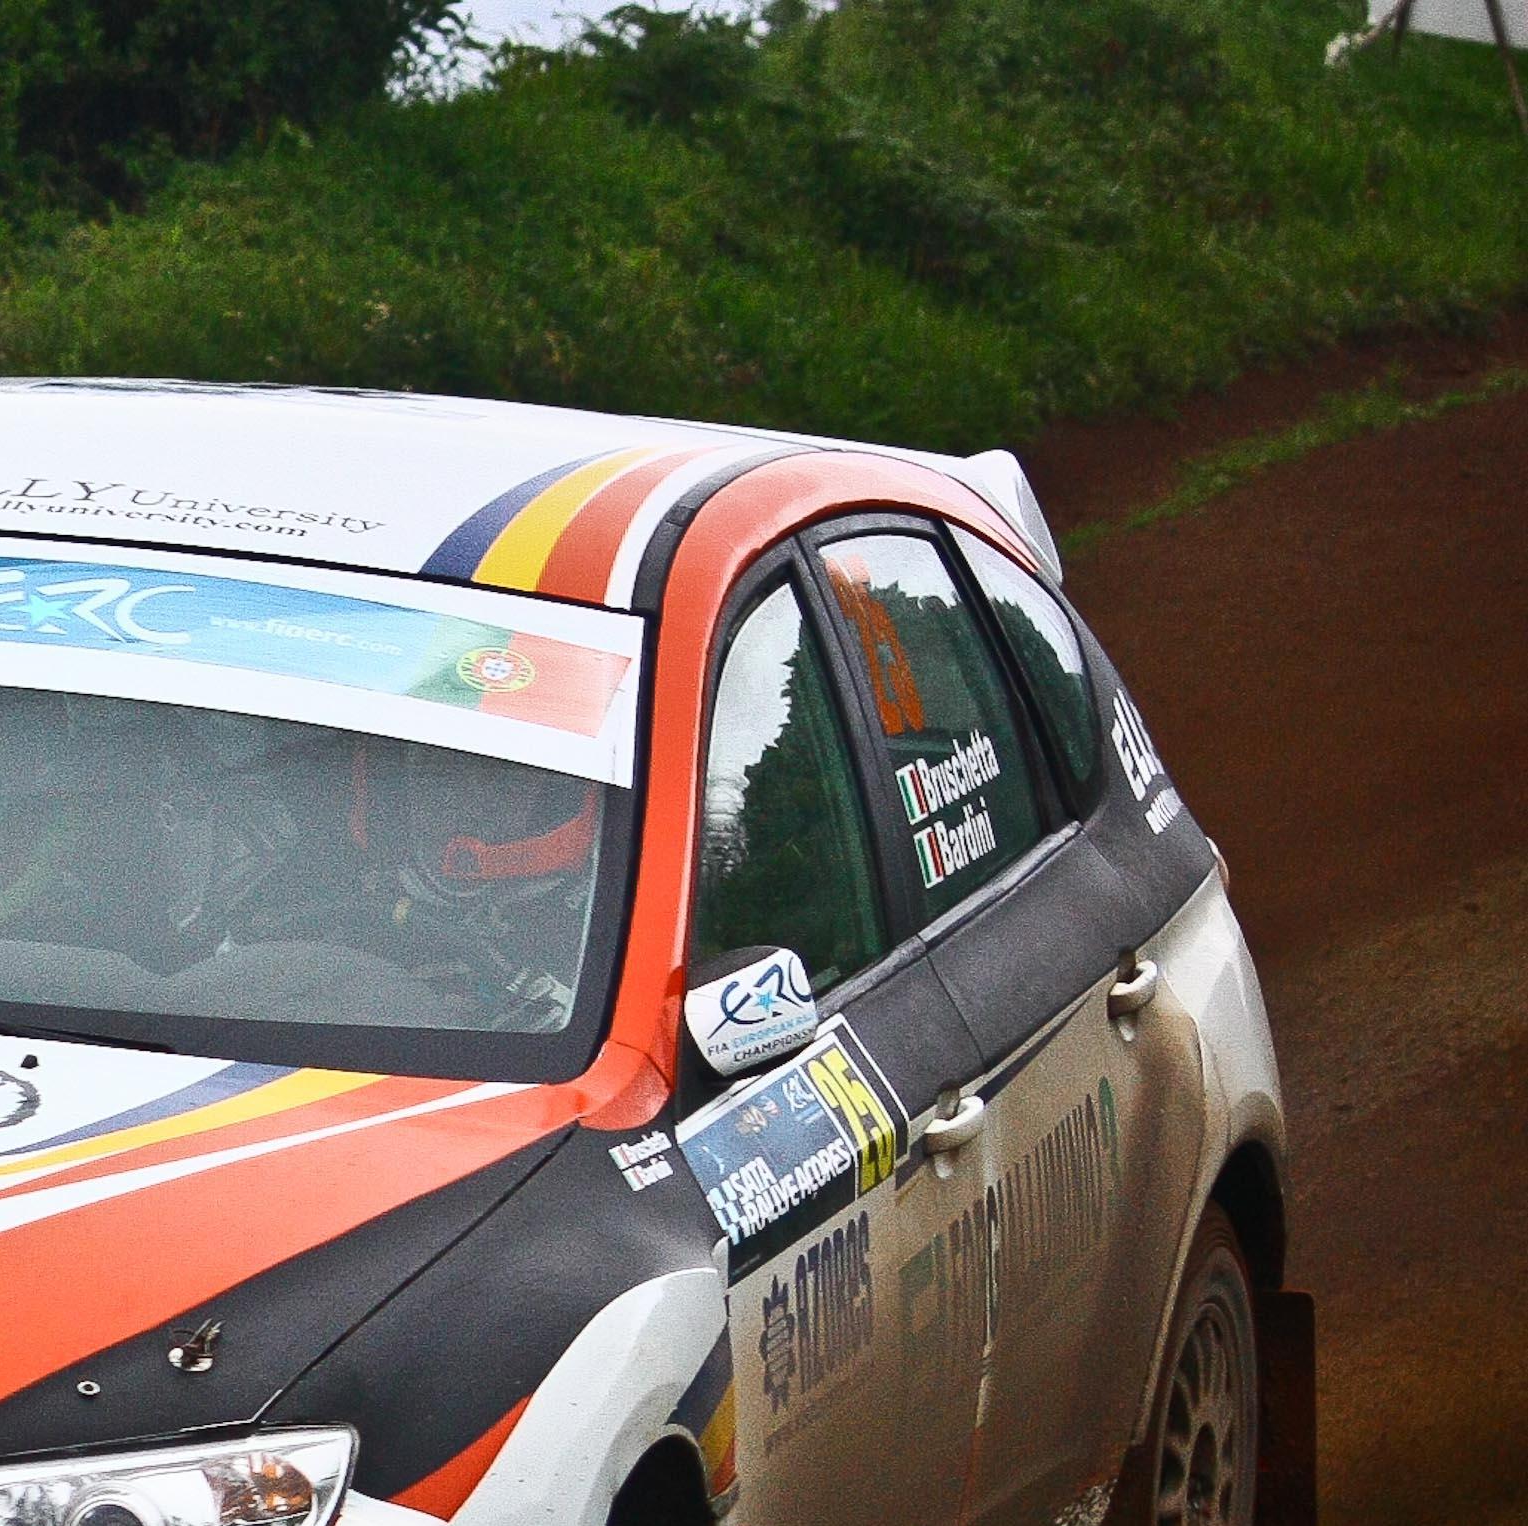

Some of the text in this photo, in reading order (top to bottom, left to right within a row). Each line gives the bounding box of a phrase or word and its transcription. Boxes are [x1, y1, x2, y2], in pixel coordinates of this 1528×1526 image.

[129, 489, 387, 535] University
[915, 728, 1001, 814] Bruschetta
[933, 795, 997, 876] Bardini
[706, 1042, 730, 1058] FIA
[808, 1046, 897, 1195] 25
